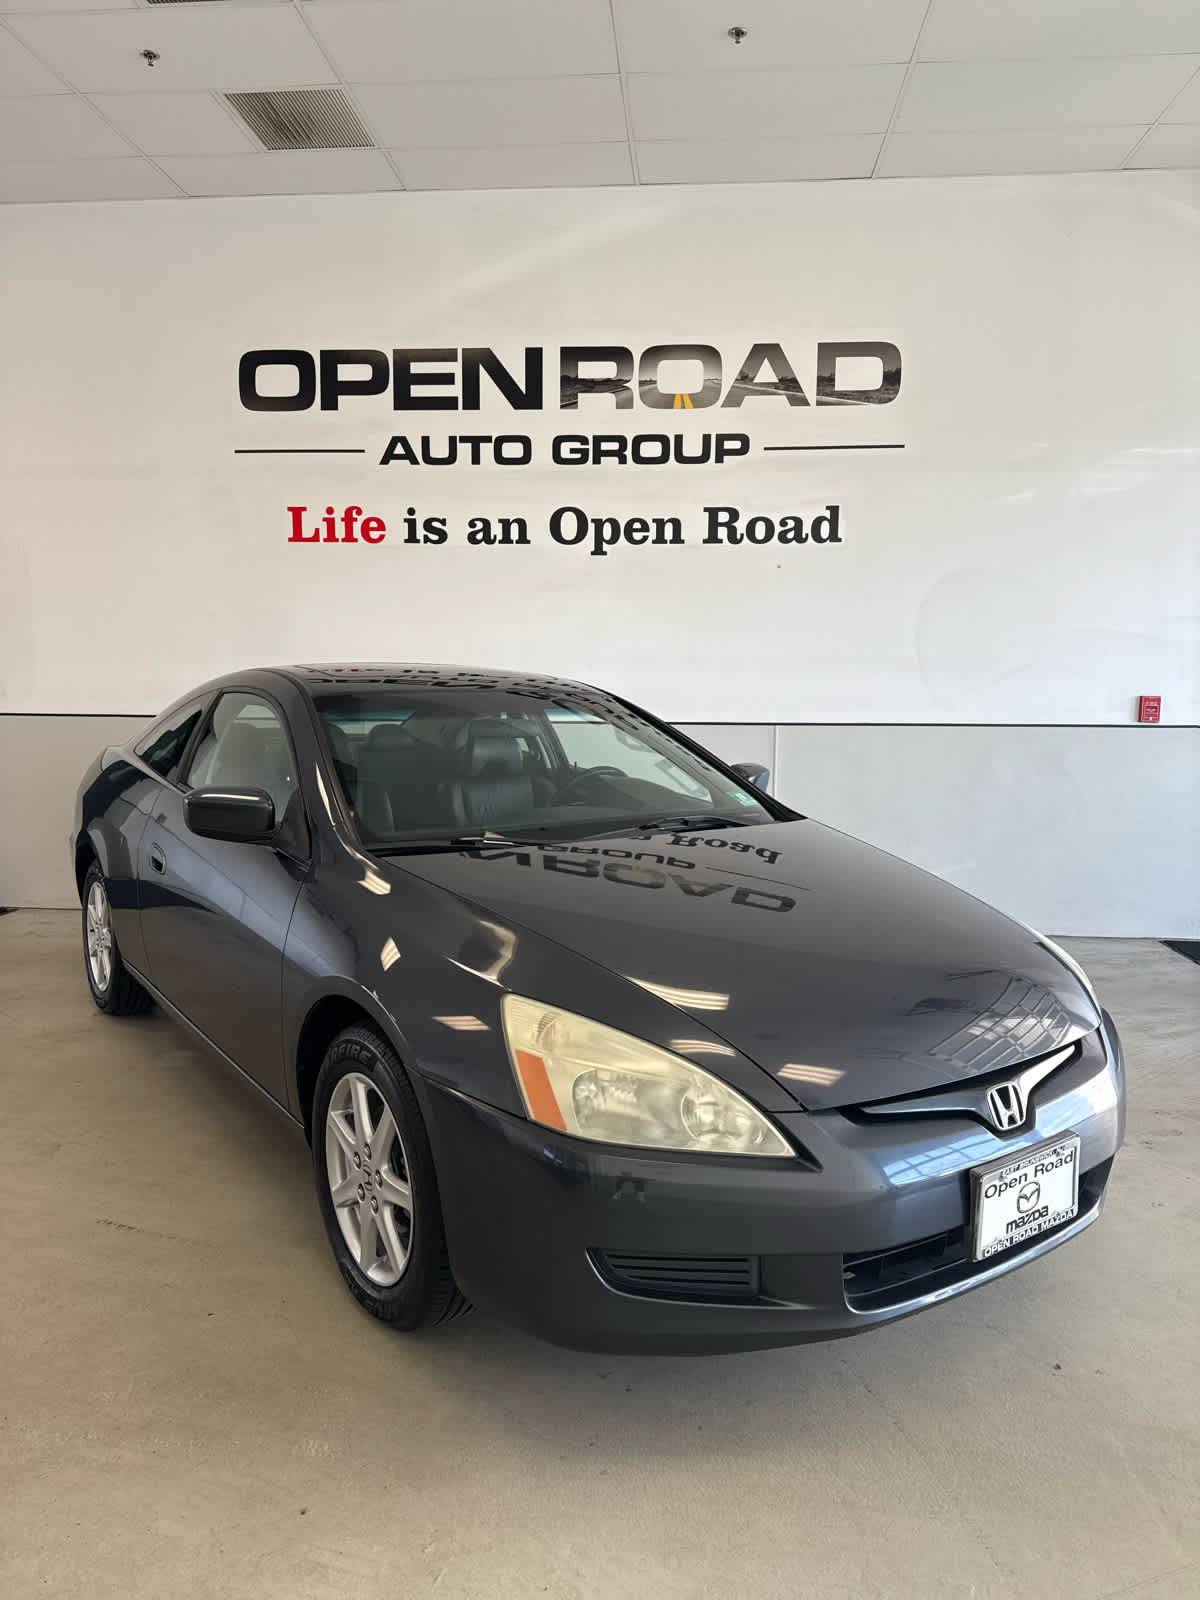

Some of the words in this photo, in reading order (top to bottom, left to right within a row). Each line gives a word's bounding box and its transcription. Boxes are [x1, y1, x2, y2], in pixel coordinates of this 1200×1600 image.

[238, 347, 543, 412] OPEN
[559, 341, 903, 410] ROAD
[378, 435, 533, 466] AUTO
[551, 432, 751, 465] GROUP
[287, 506, 387, 544] Life
[403, 506, 449, 545] is
[466, 517, 532, 545] an
[548, 506, 686, 557] Open
[701, 505, 843, 545] Road
[984, 1172, 1028, 1199] Open
[1034, 1150, 1073, 1178] Road
[984, 1238, 1010, 1257] OPEN
[1012, 1226, 1039, 1243] ROAD
[1041, 1210, 1073, 1230] MAZDA
